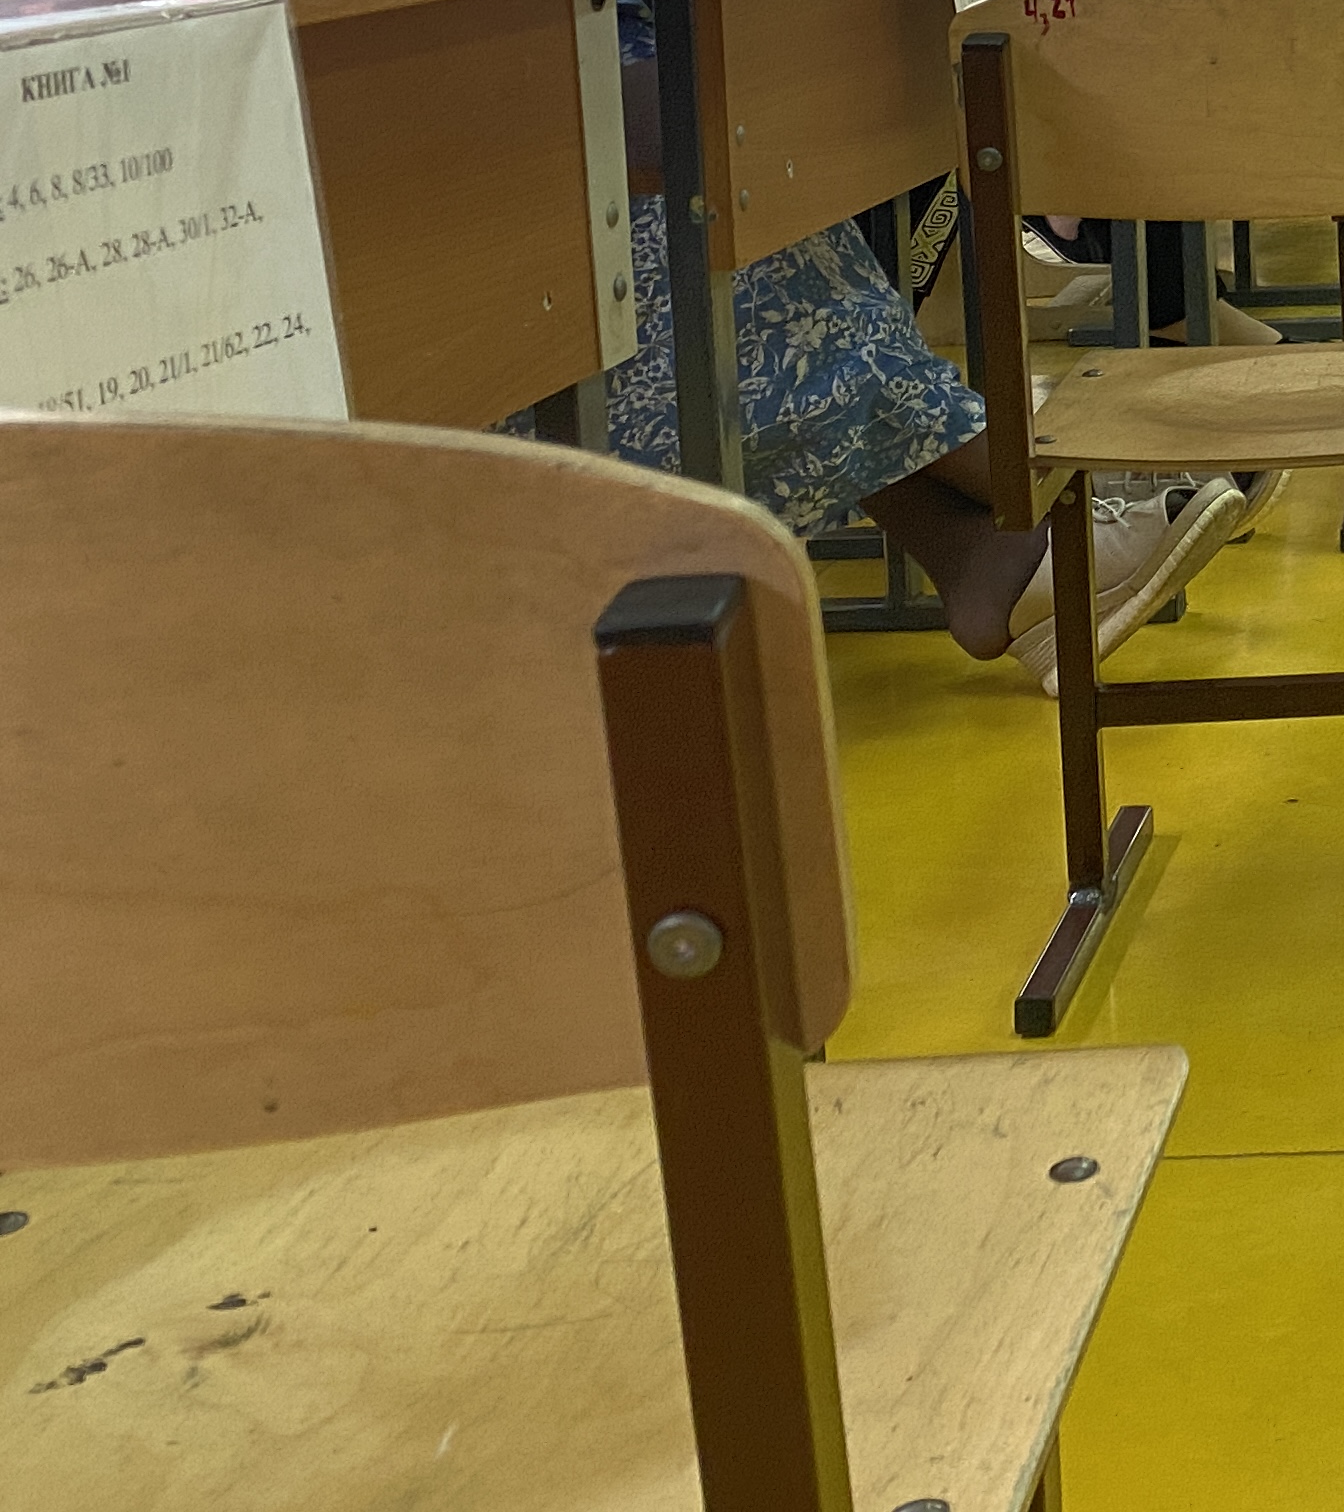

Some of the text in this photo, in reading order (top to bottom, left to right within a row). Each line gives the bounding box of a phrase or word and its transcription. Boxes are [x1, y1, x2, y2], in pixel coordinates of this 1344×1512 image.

[21, 59, 131, 103] КНИГА №1
[14, 263, 42, 293] 26,
[100, 238, 129, 268] 28,
[219, 200, 264, 232] 32-А,
[97, 375, 125, 407] 19,
[128, 366, 156, 395] 20,
[158, 349, 199, 385] 21/1,
[200, 331, 250, 368] 21/62,
[251, 321, 281, 350] 22,
[282, 311, 313, 340] 24,
